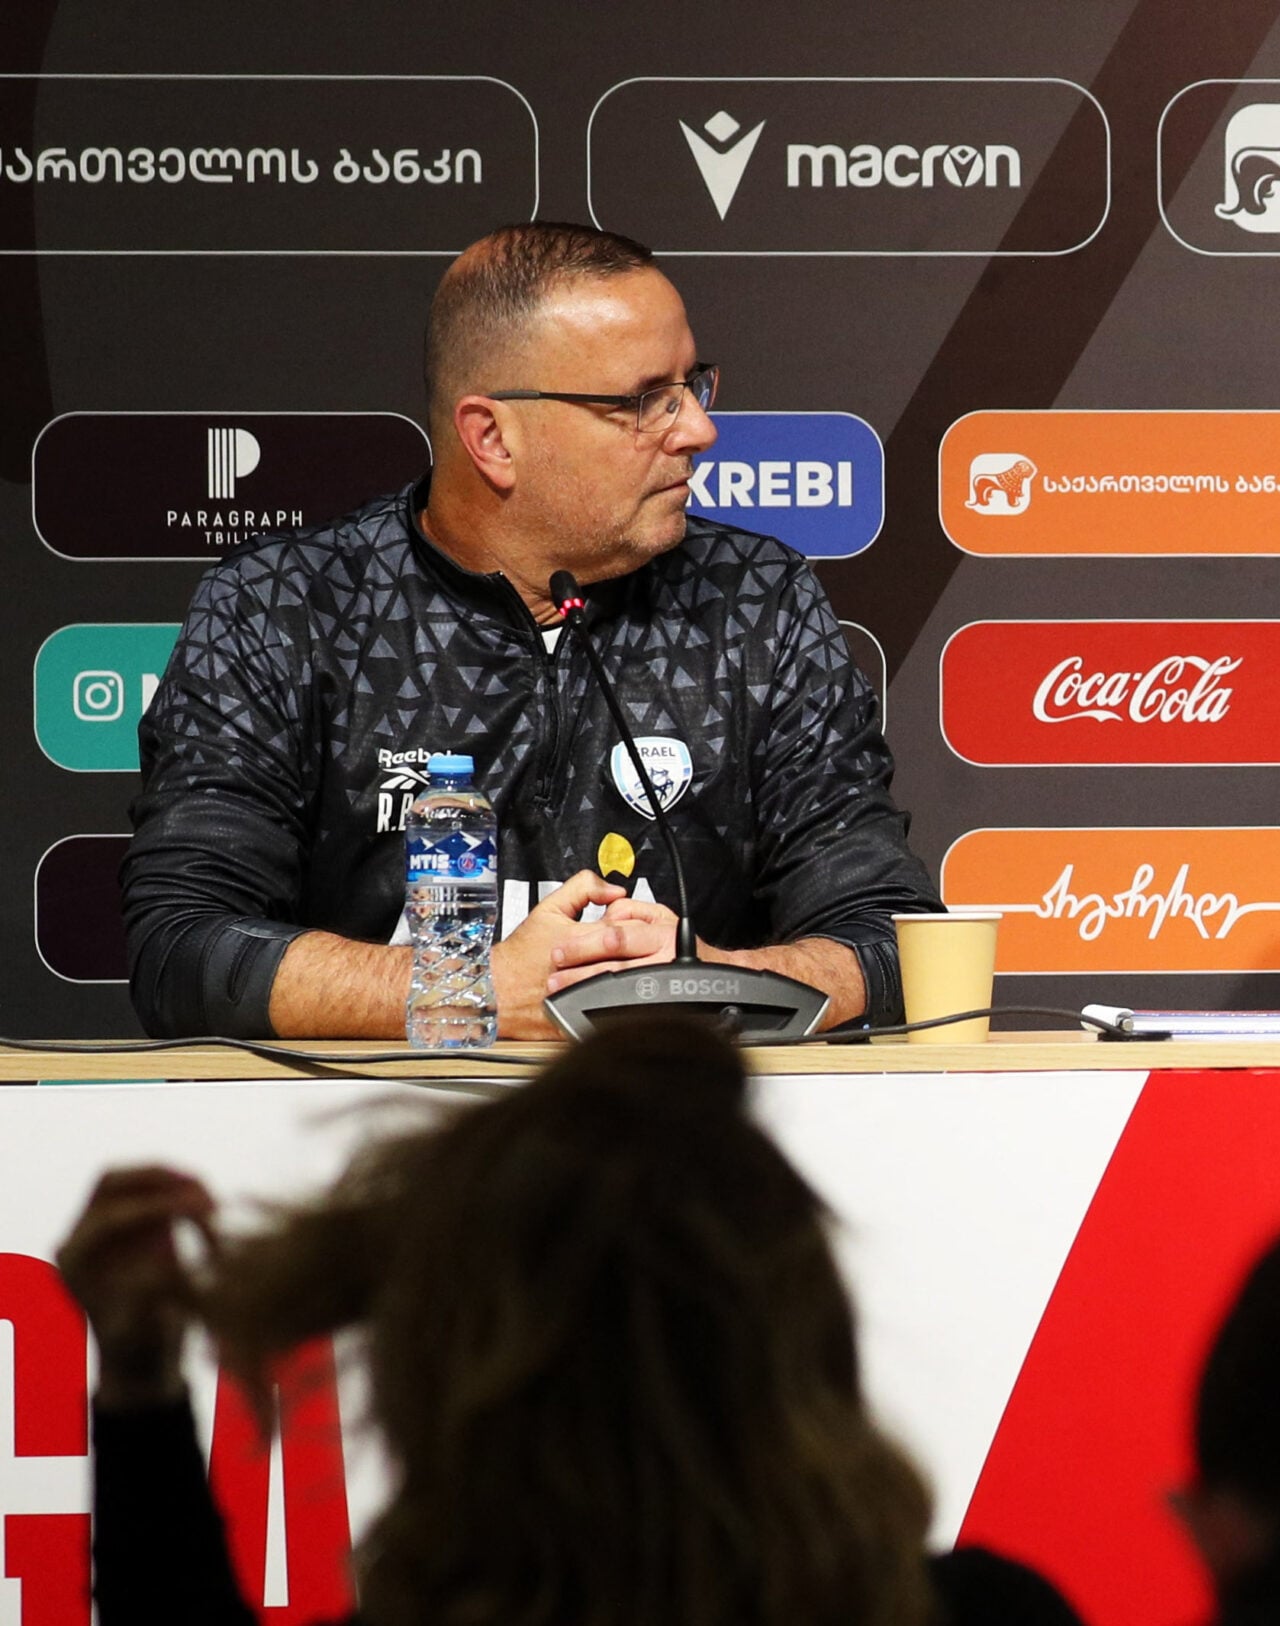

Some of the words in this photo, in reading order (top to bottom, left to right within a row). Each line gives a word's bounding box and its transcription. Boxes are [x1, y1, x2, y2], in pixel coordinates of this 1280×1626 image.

[0, 147, 319, 184] ართველოს
[332, 147, 482, 184] ბანკი
[787, 144, 1021, 187] macron
[686, 461, 853, 508] KREBI
[1043, 475, 1230, 494] საქართველოს
[166, 510, 303, 528] PARAGRAPH
[204, 531, 267, 545] TBIL
[1032, 655, 1243, 724] Coca-Cola
[378, 747, 452, 768] Reeb
[637, 746, 676, 758] RAEL
[669, 979, 740, 995] BOSCH
